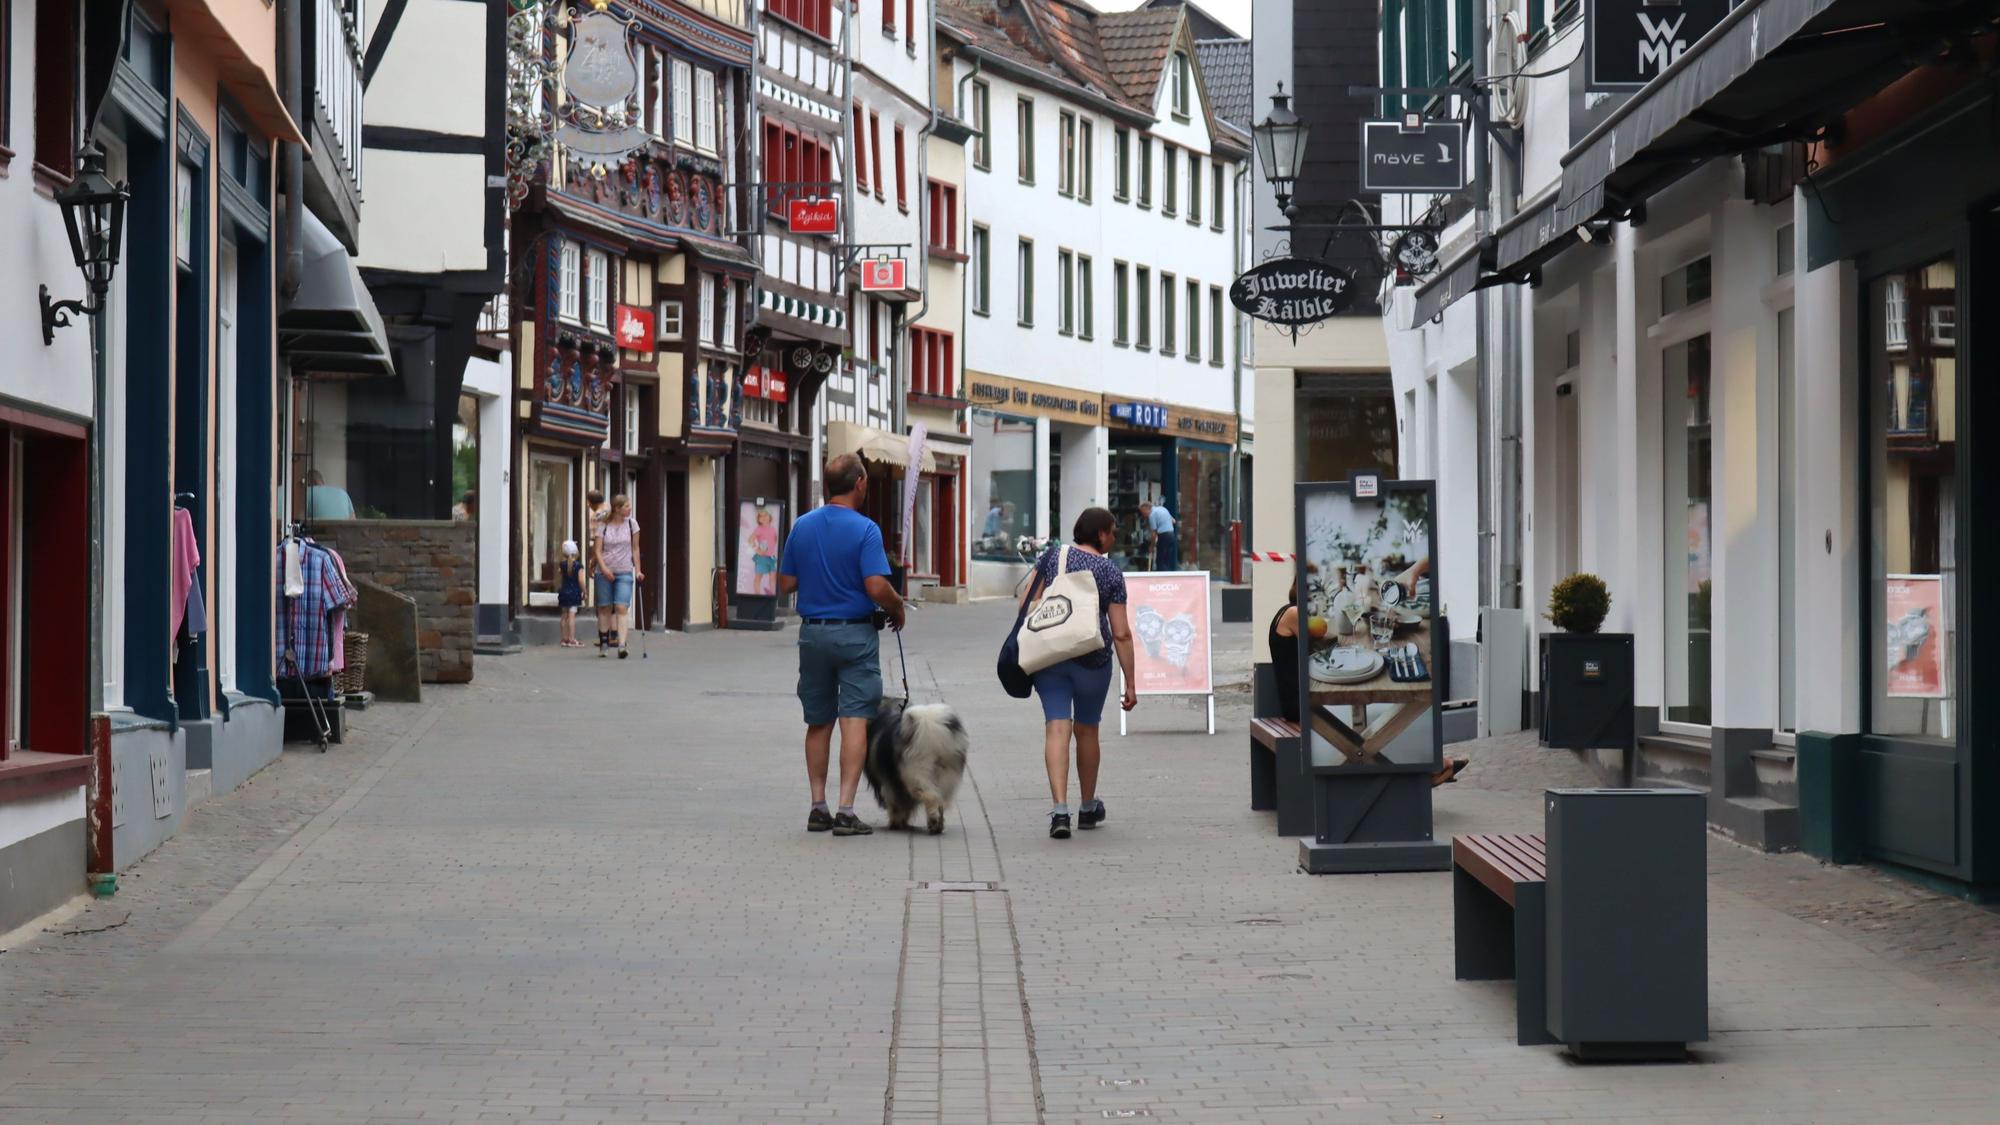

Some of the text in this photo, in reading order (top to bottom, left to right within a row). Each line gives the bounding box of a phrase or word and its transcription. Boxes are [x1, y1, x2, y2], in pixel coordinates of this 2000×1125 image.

[1240, 268, 1347, 302] Juwelier
[1251, 296, 1335, 320] Kälble
[1135, 404, 1168, 428] ROTH
